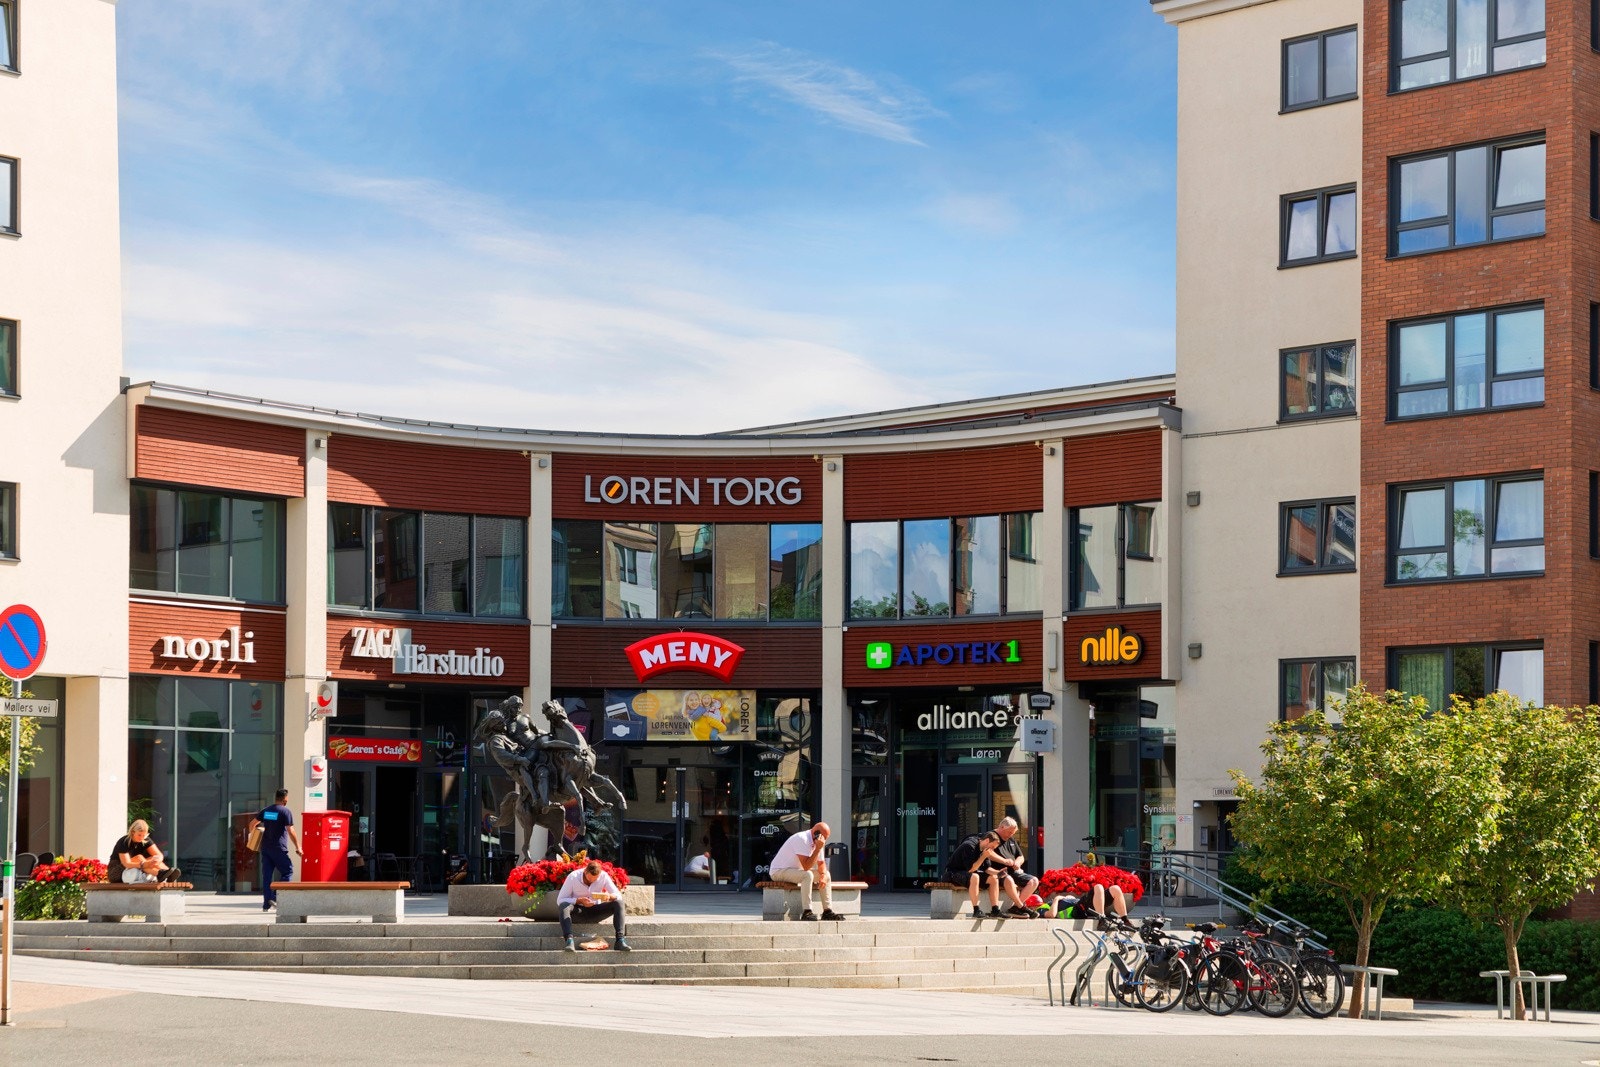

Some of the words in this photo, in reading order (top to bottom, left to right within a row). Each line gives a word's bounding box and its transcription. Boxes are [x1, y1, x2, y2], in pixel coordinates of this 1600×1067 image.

[706, 477, 802, 505] TORG
[160, 626, 257, 663] norli
[351, 627, 404, 659] ZAGA
[403, 644, 505, 676] Hårstudio
[639, 641, 733, 669] MENY
[896, 641, 1004, 666] APOTEK
[1005, 640, 1022, 663] 1
[1081, 627, 1139, 662] nille
[4, 701, 34, 713] Møllers
[38, 703, 51, 714] vei
[971, 747, 1001, 759] Løren
[896, 807, 936, 818] Synsklinikk
